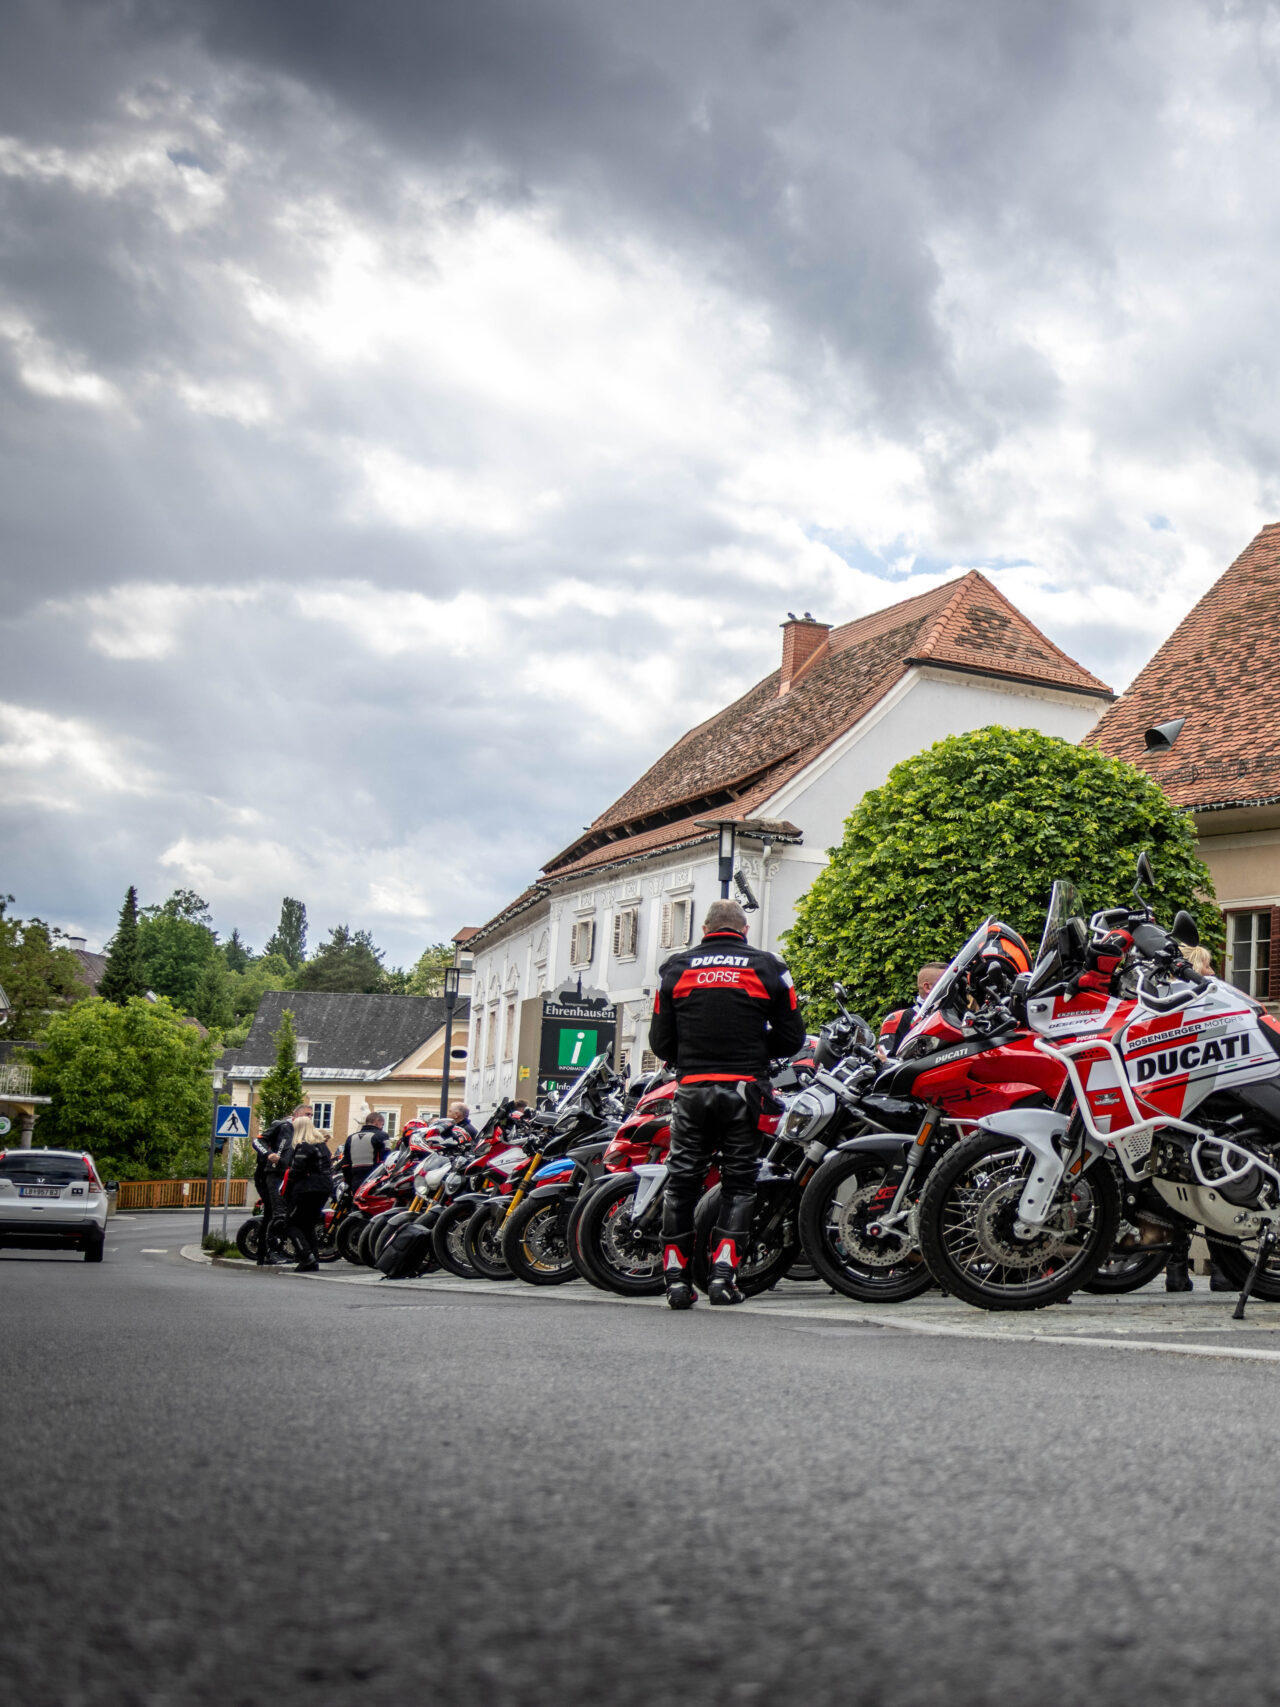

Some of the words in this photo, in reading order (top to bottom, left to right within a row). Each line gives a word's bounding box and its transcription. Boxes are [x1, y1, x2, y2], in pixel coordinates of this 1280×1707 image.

[691, 955, 750, 968] DUCATI
[697, 971, 741, 984] CORSE
[545, 1005, 615, 1019] Ehrenhausen
[1076, 1034, 1098, 1042] DUCATI
[1128, 1024, 1202, 1049] ROSENBERGER
[1204, 1015, 1244, 1029] MOTORS
[935, 1048, 968, 1064] DUCATI
[1136, 1033, 1250, 1083] DUCATI
[556, 1082, 573, 1091] Info
